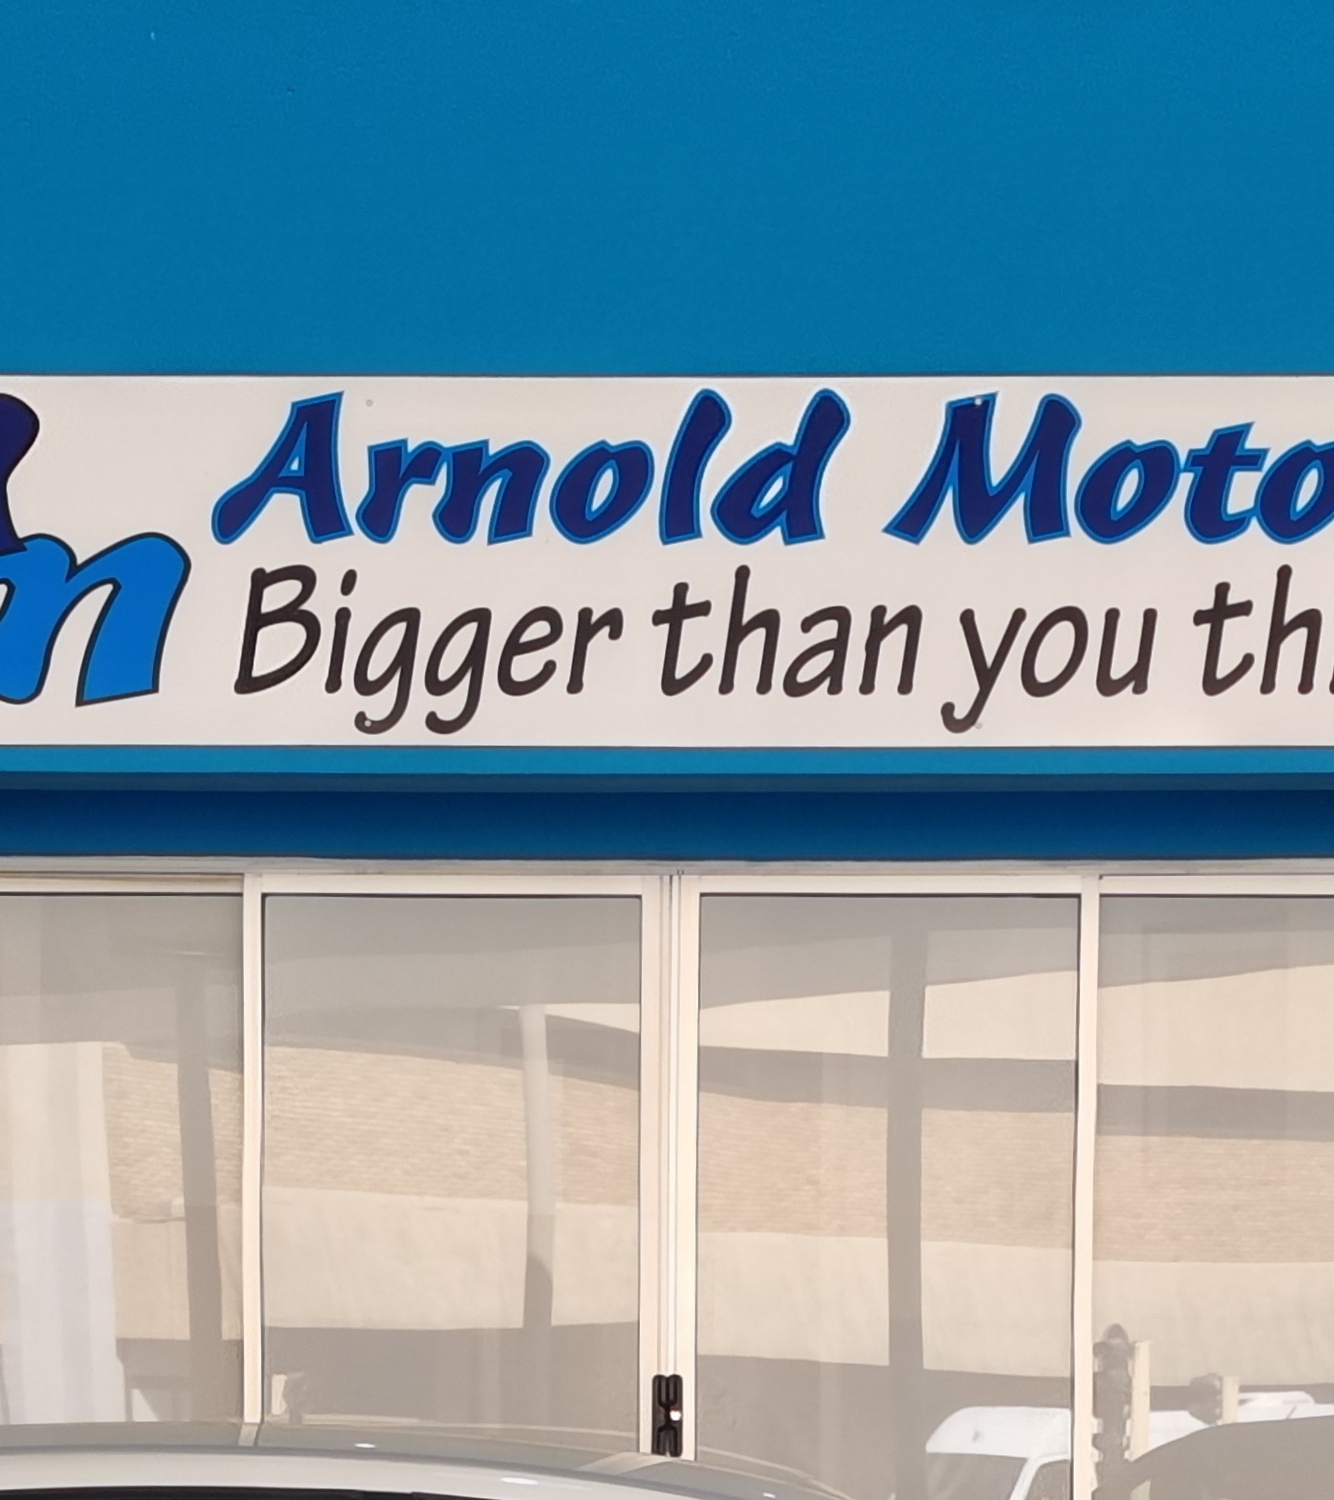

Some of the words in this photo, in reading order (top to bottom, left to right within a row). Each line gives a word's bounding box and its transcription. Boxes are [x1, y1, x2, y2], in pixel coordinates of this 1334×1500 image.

[211, 388, 851, 545] Arnold
[234, 564, 623, 734] Bigger
[651, 564, 924, 697] than
[940, 606, 1157, 733] you
